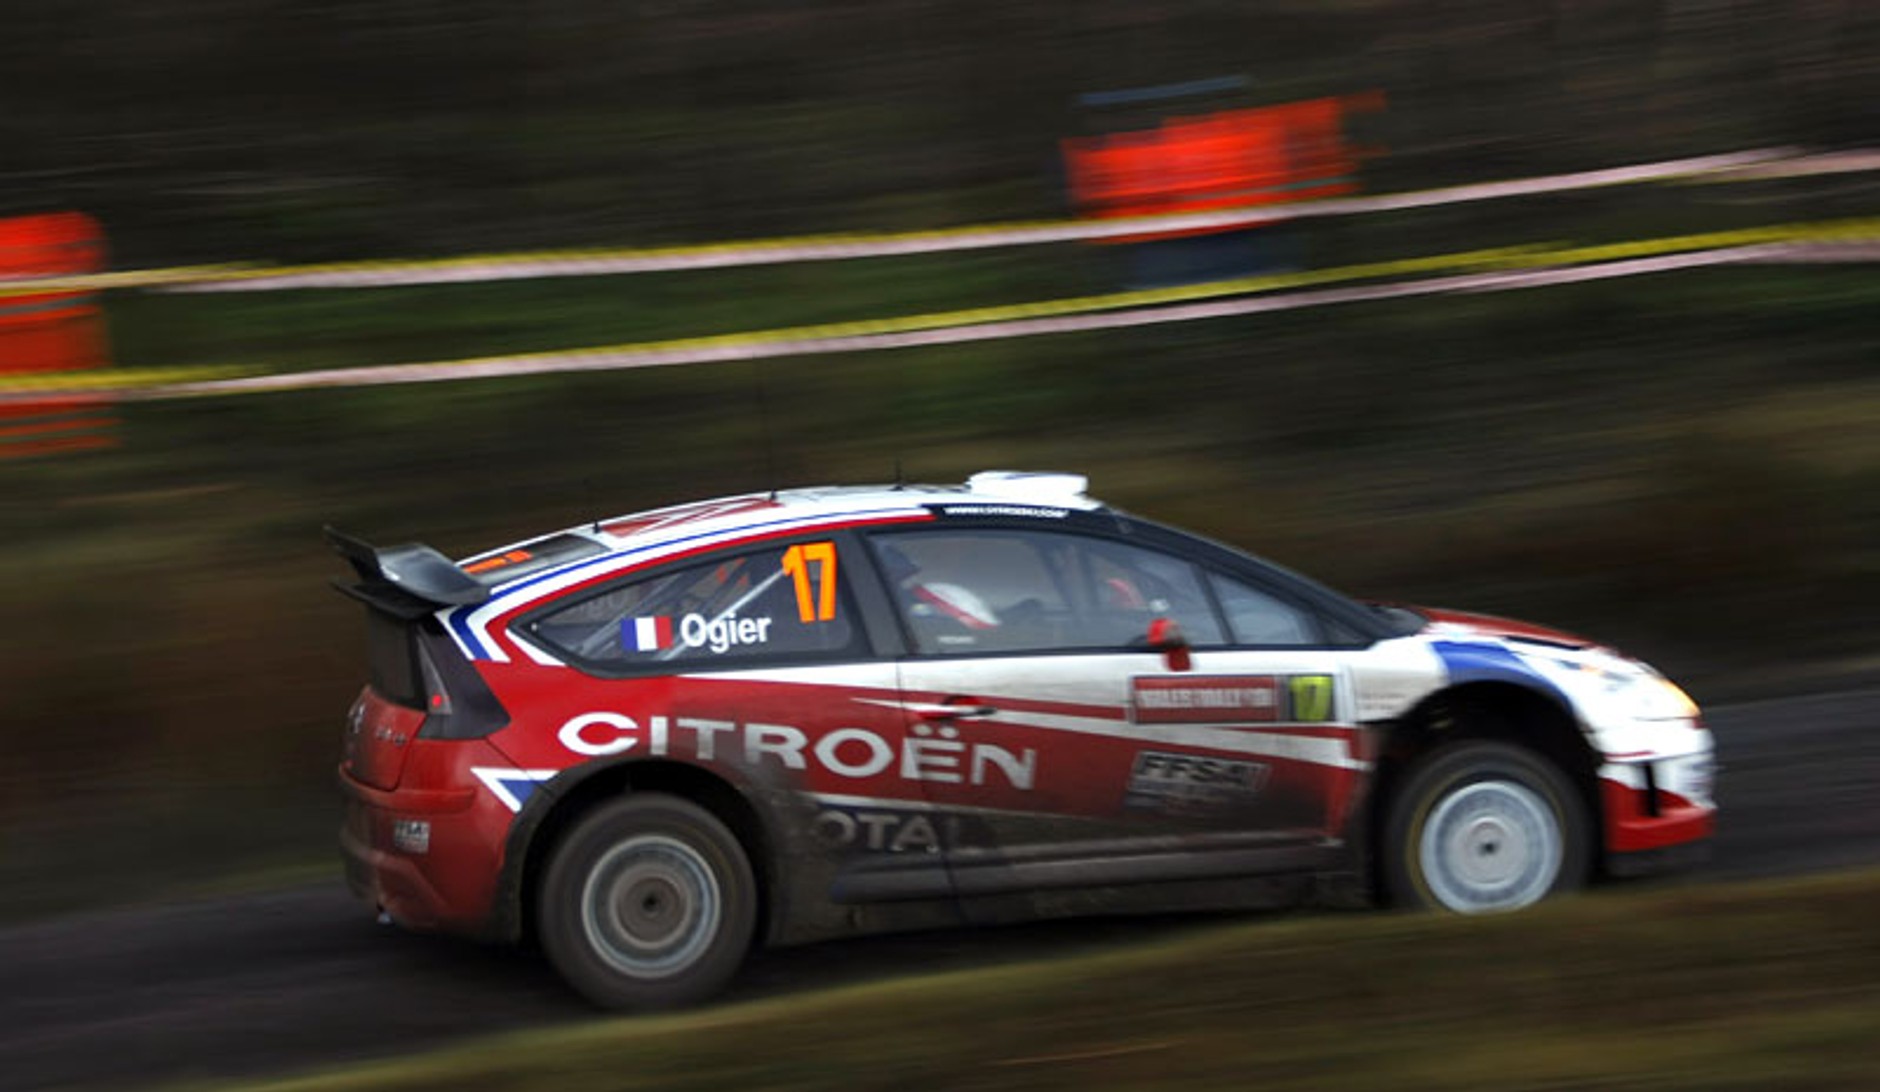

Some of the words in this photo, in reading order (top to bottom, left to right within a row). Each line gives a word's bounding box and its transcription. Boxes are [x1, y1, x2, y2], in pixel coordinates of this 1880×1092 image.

[781, 541, 838, 622] 17
[680, 613, 772, 653] Ogier
[558, 711, 1037, 790] CITROËN
